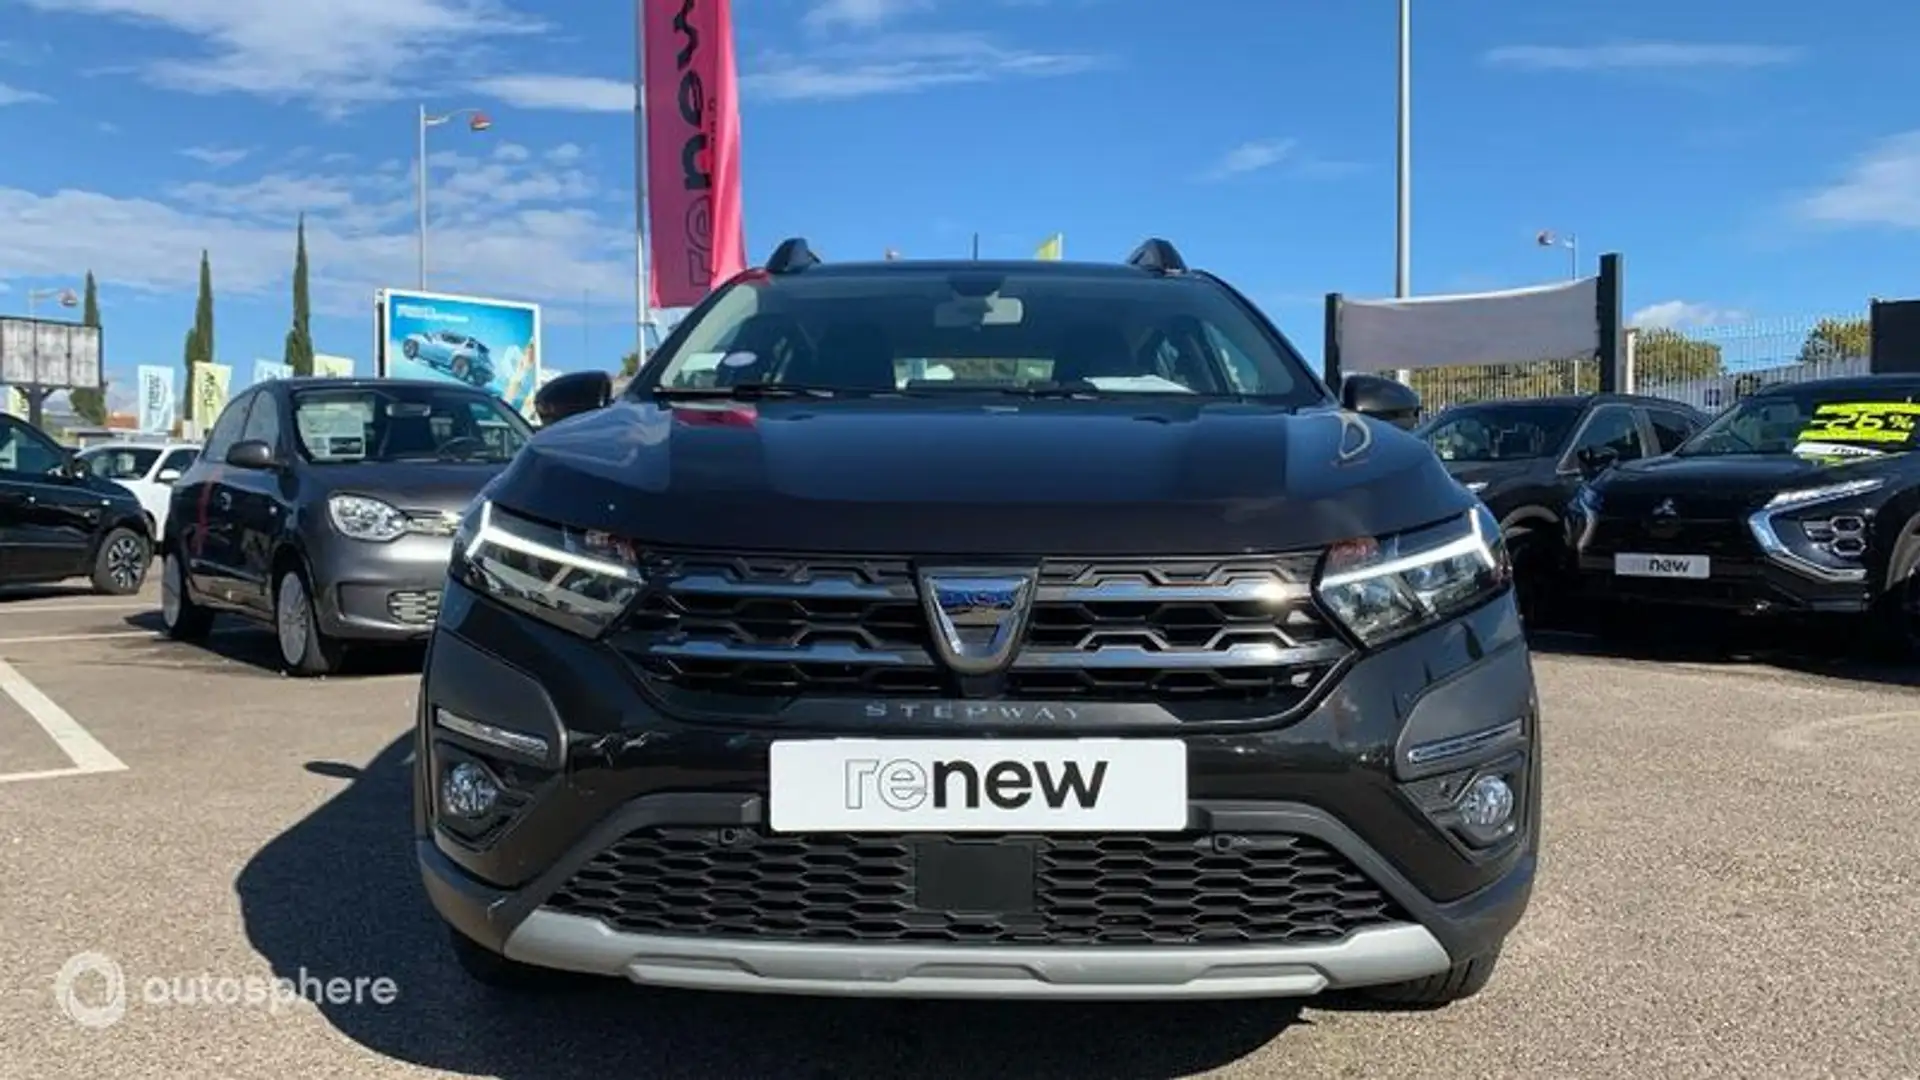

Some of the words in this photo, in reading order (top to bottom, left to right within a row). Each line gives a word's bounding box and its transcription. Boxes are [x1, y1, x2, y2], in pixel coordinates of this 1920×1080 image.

[1811, 410, 1915, 430] -26%
[865, 703, 1079, 720] STEPWAY
[844, 758, 1108, 811] renew
